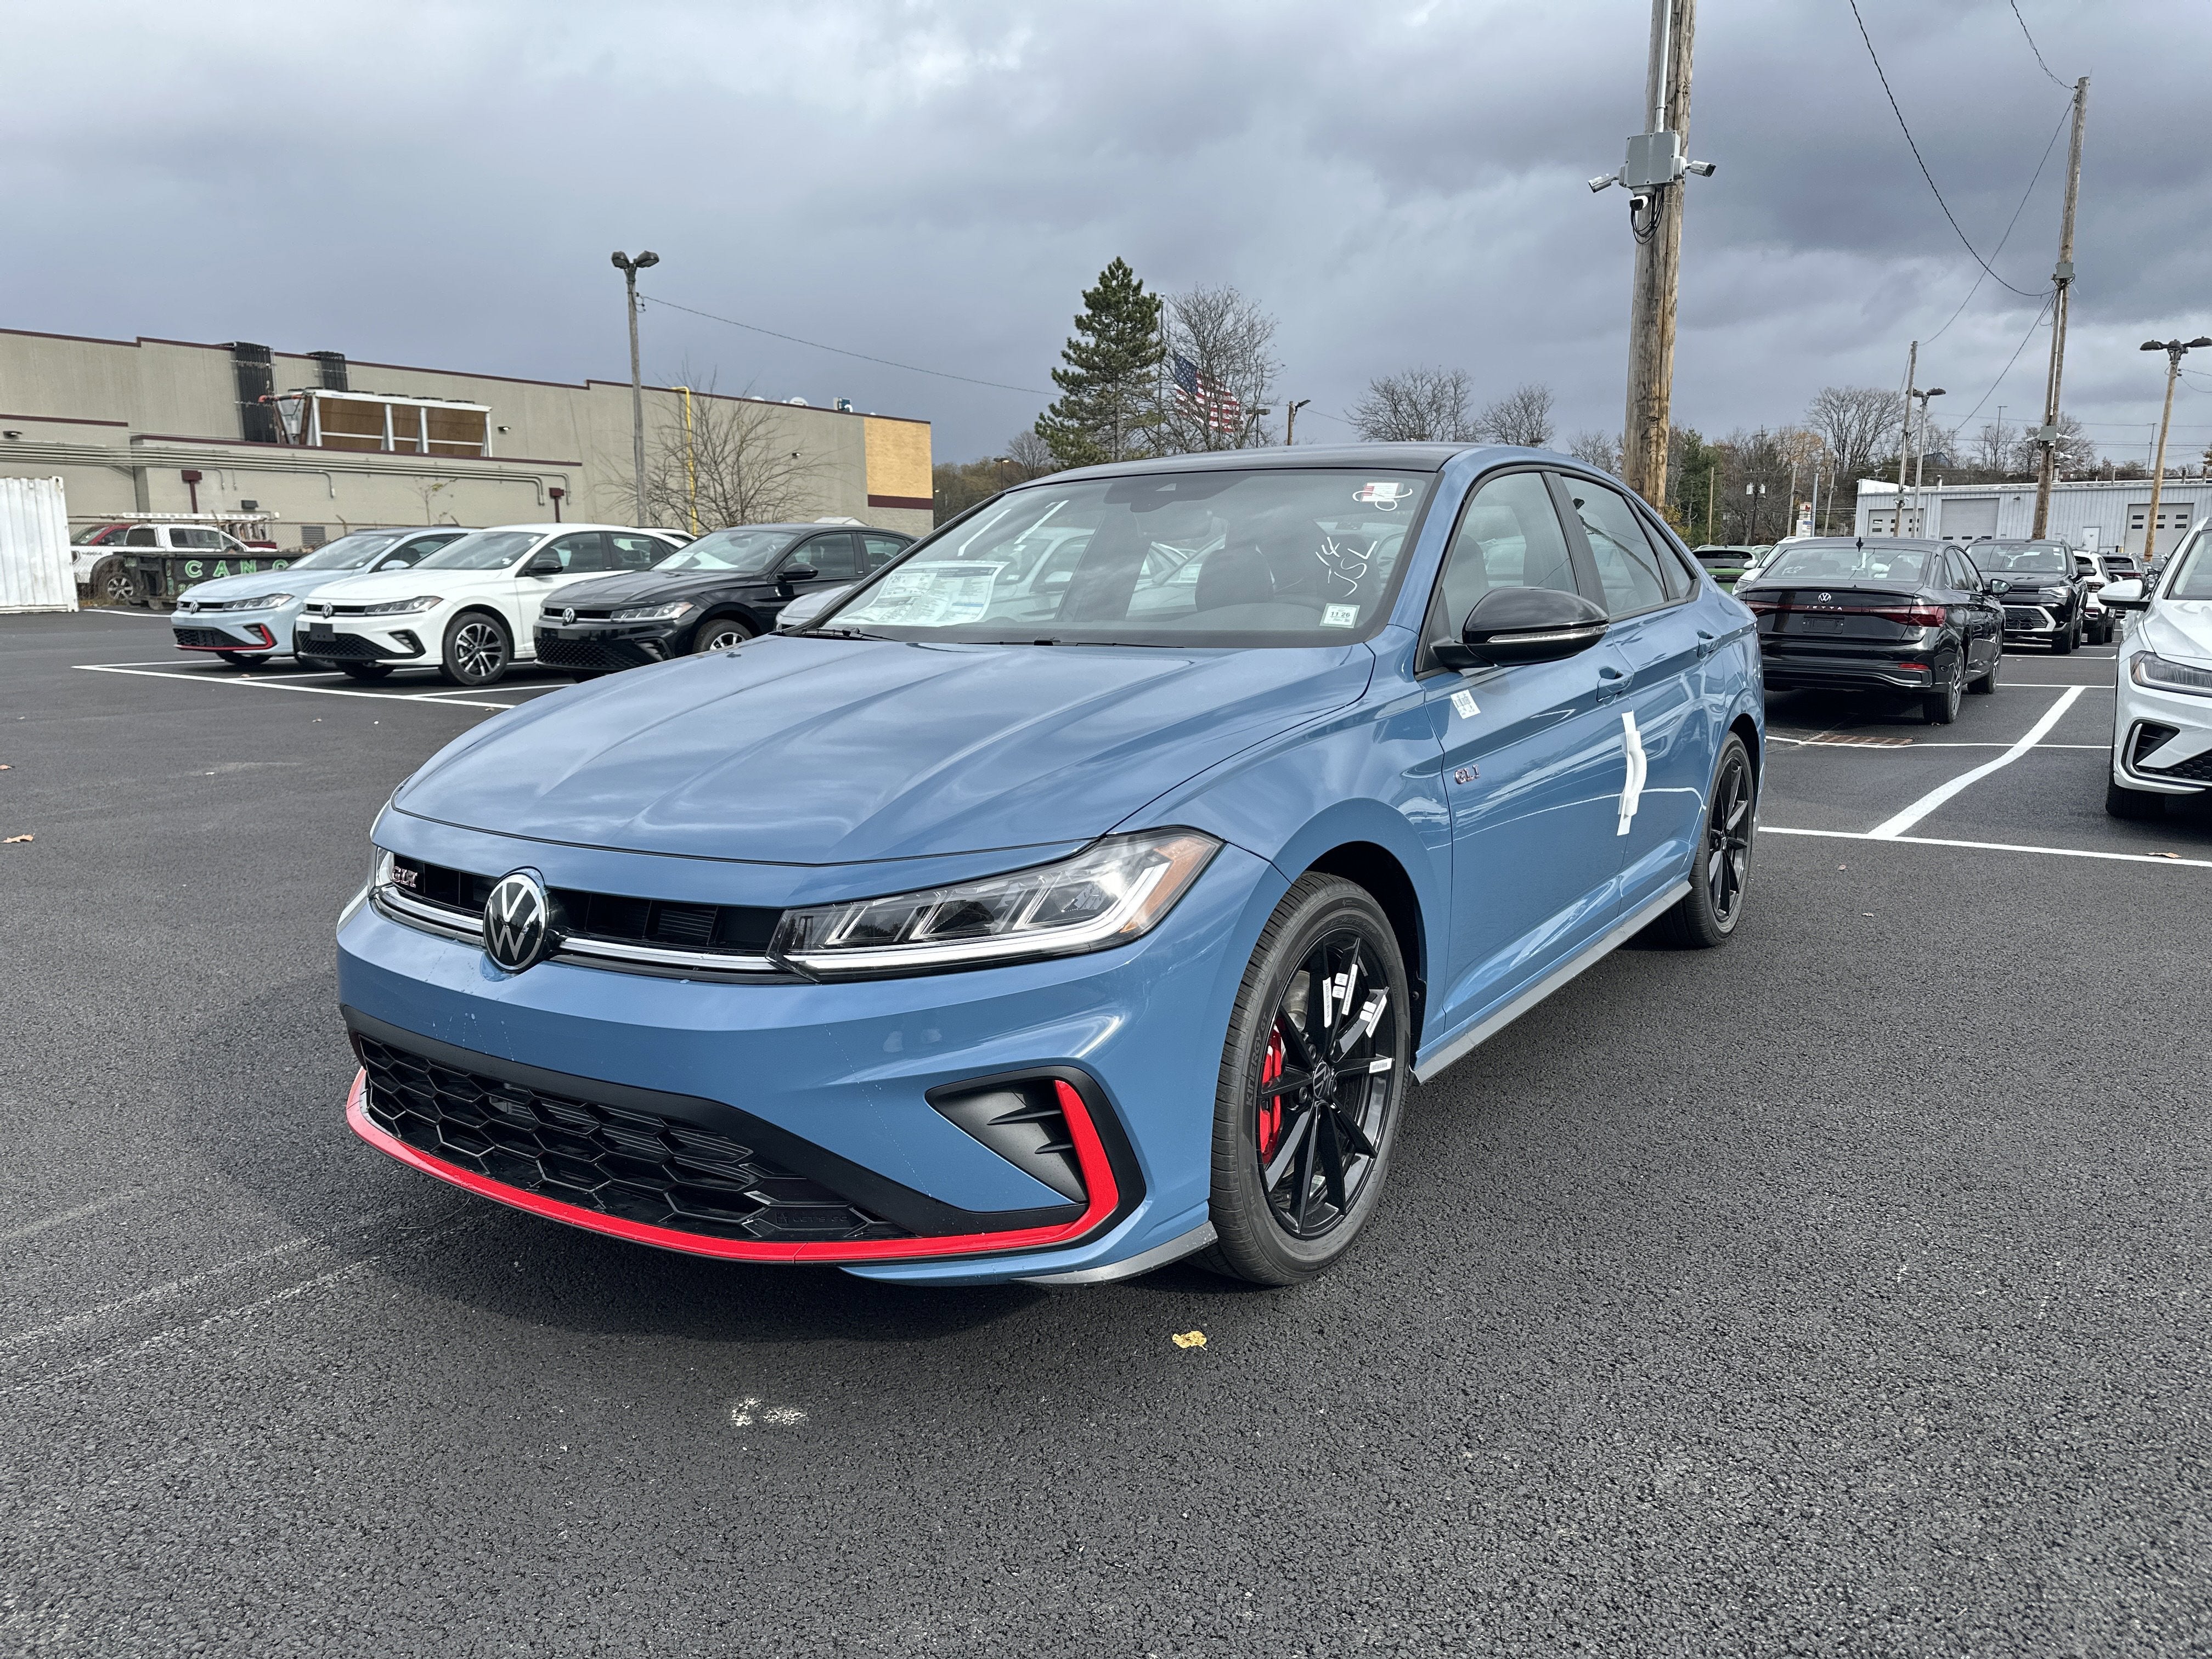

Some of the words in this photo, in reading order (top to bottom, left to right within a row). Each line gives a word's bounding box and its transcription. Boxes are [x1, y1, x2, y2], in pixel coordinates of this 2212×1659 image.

[1454, 764, 1480, 785] GLI
[392, 866, 418, 888] GLI
[1246, 1029, 1263, 1107] KINERGY
[1260, 1011, 1268, 1032] GT
